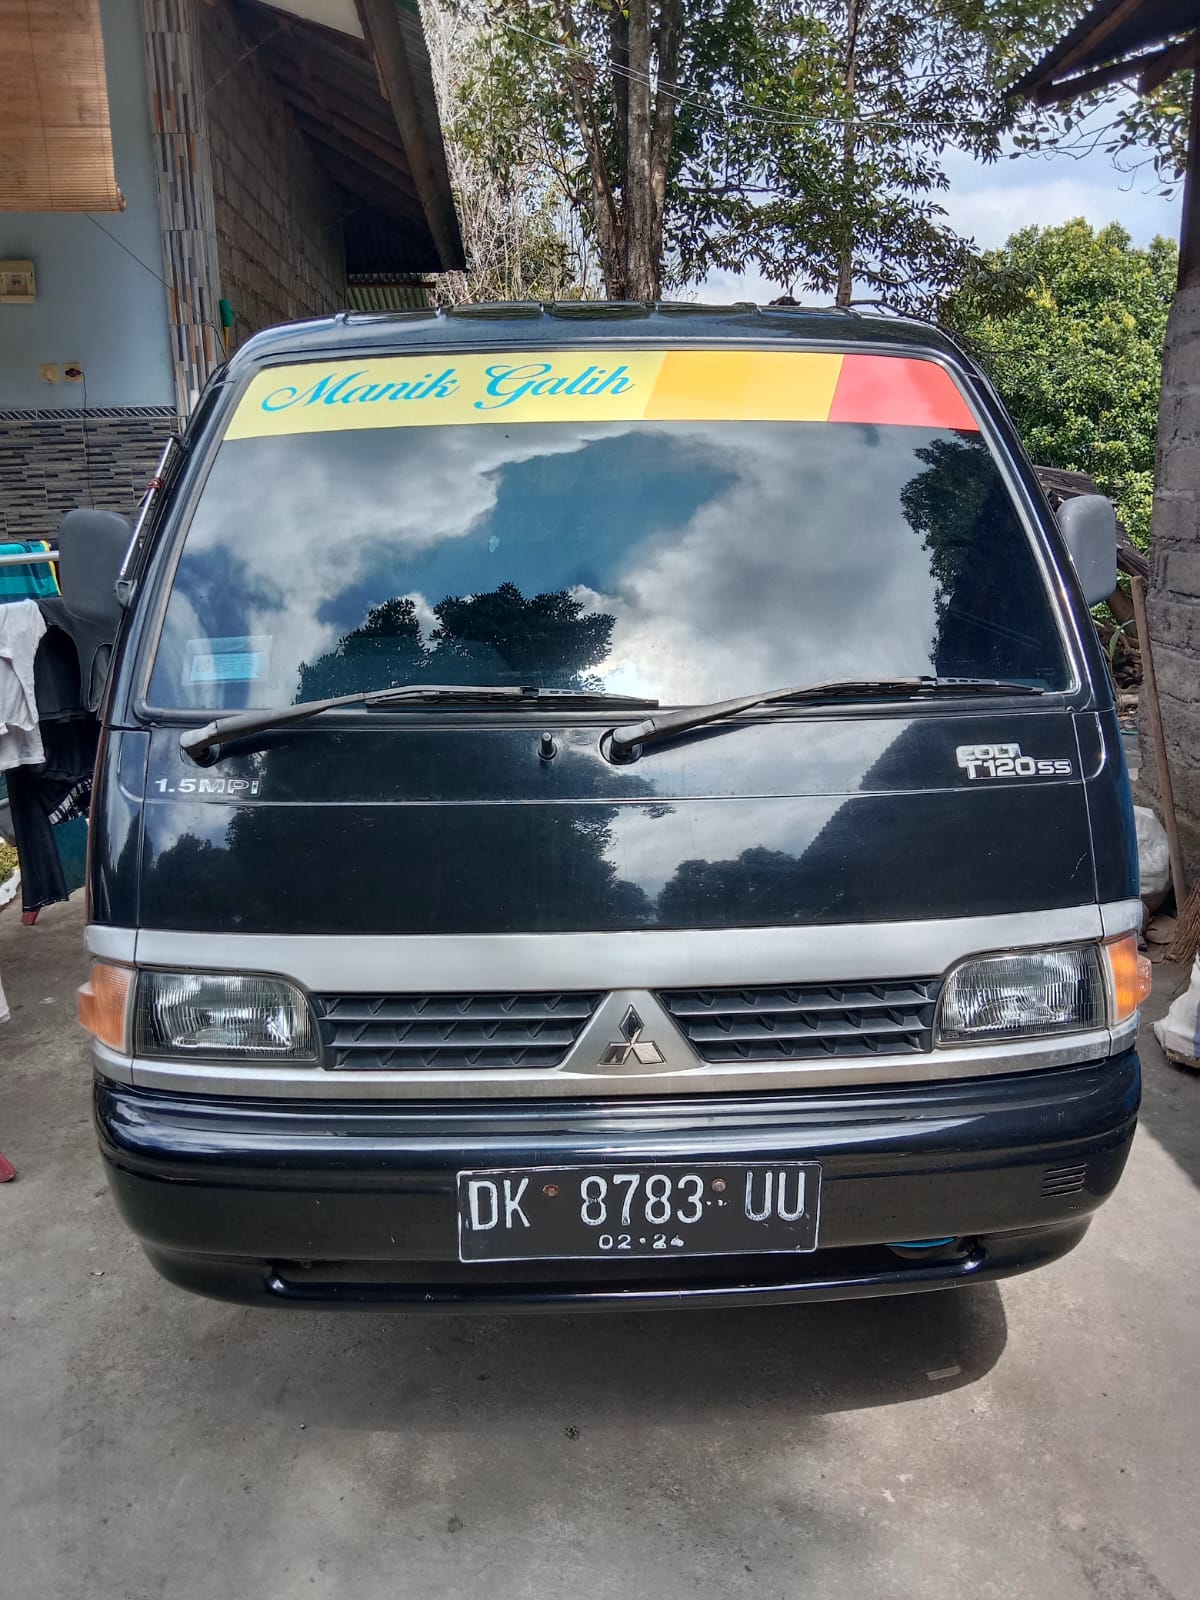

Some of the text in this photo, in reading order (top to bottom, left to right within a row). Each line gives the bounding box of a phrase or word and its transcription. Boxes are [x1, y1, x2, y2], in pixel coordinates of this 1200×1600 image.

[262, 363, 635, 412] Manik Galih
[957, 743, 1020, 761] COLT
[468, 1171, 806, 1231] DK 8783 UU
